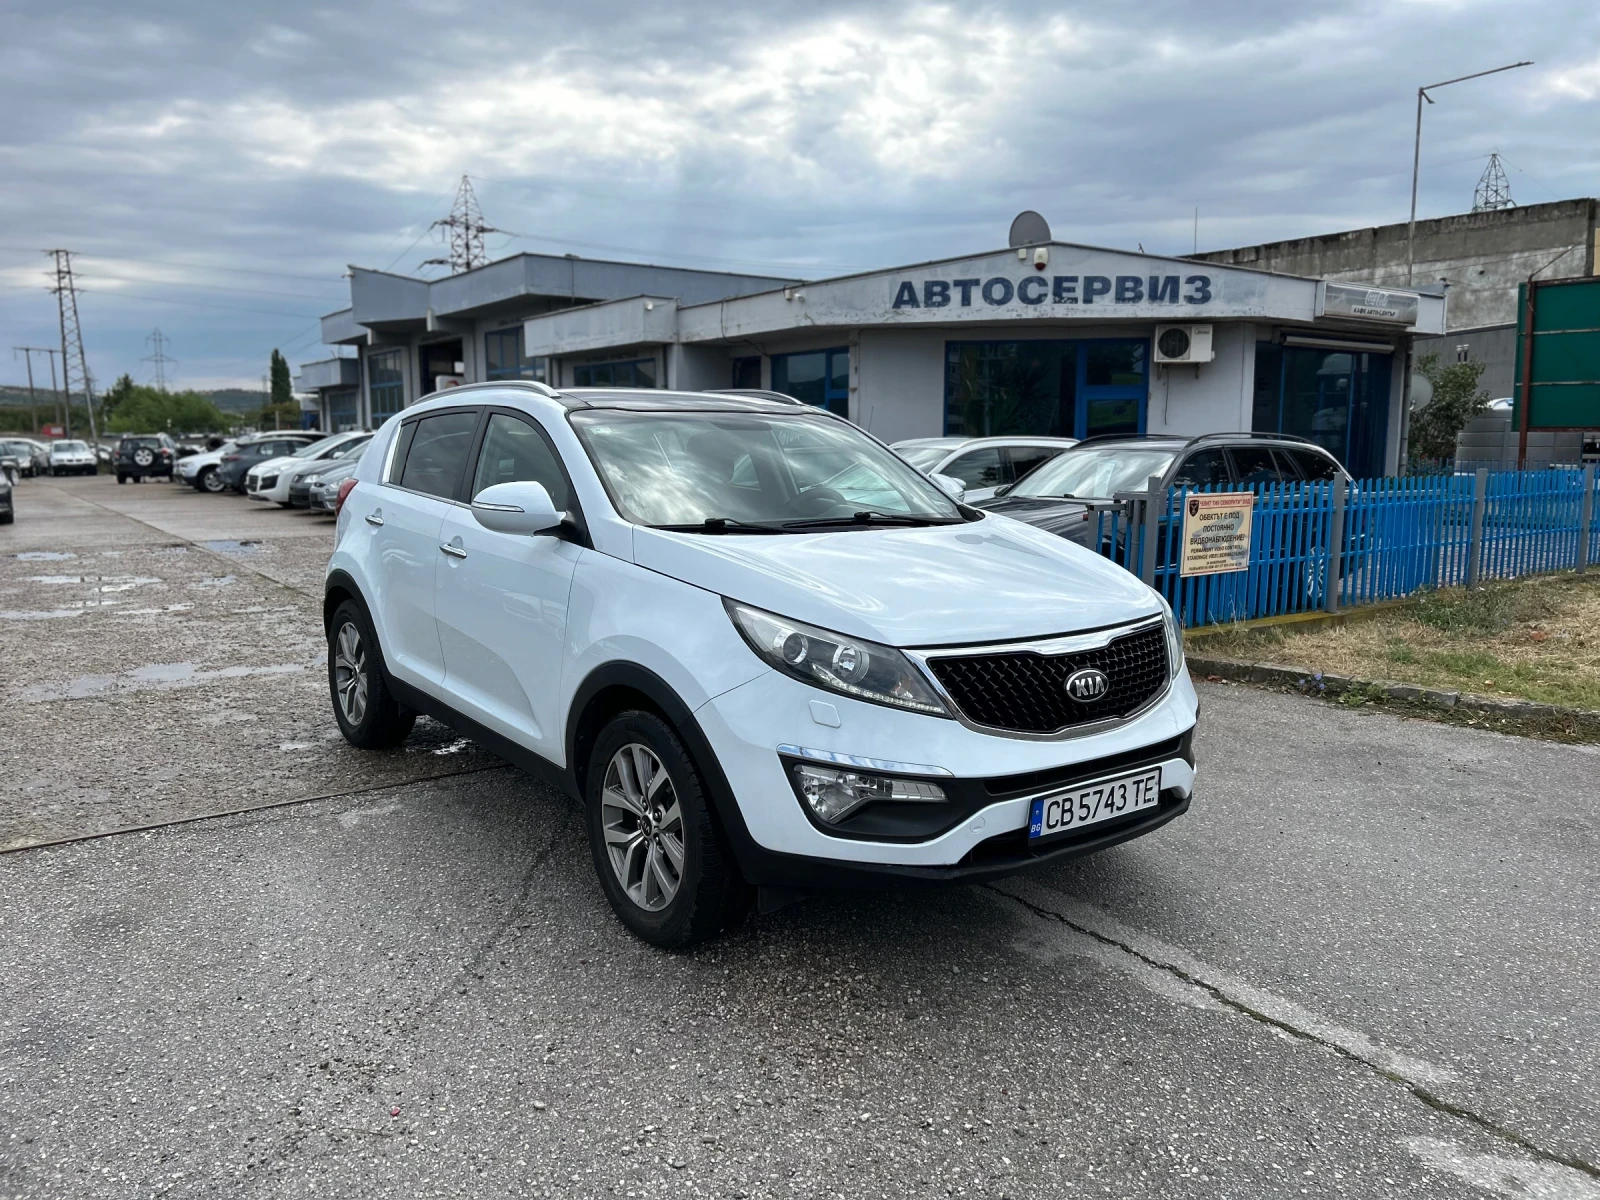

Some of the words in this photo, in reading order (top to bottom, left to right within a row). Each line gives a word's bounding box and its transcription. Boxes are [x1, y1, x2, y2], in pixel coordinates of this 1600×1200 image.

[892, 275, 1213, 309] АВТОСЕРВИЗ
[1200, 513, 1223, 521] ОБЕКТЪТ
[1229, 512, 1239, 520] ПОД
[1203, 524, 1234, 532] ПОСТОЯННО
[1075, 675, 1105, 697] KIA
[1078, 783, 1127, 821] 5743
[1030, 824, 1041, 833] BG
